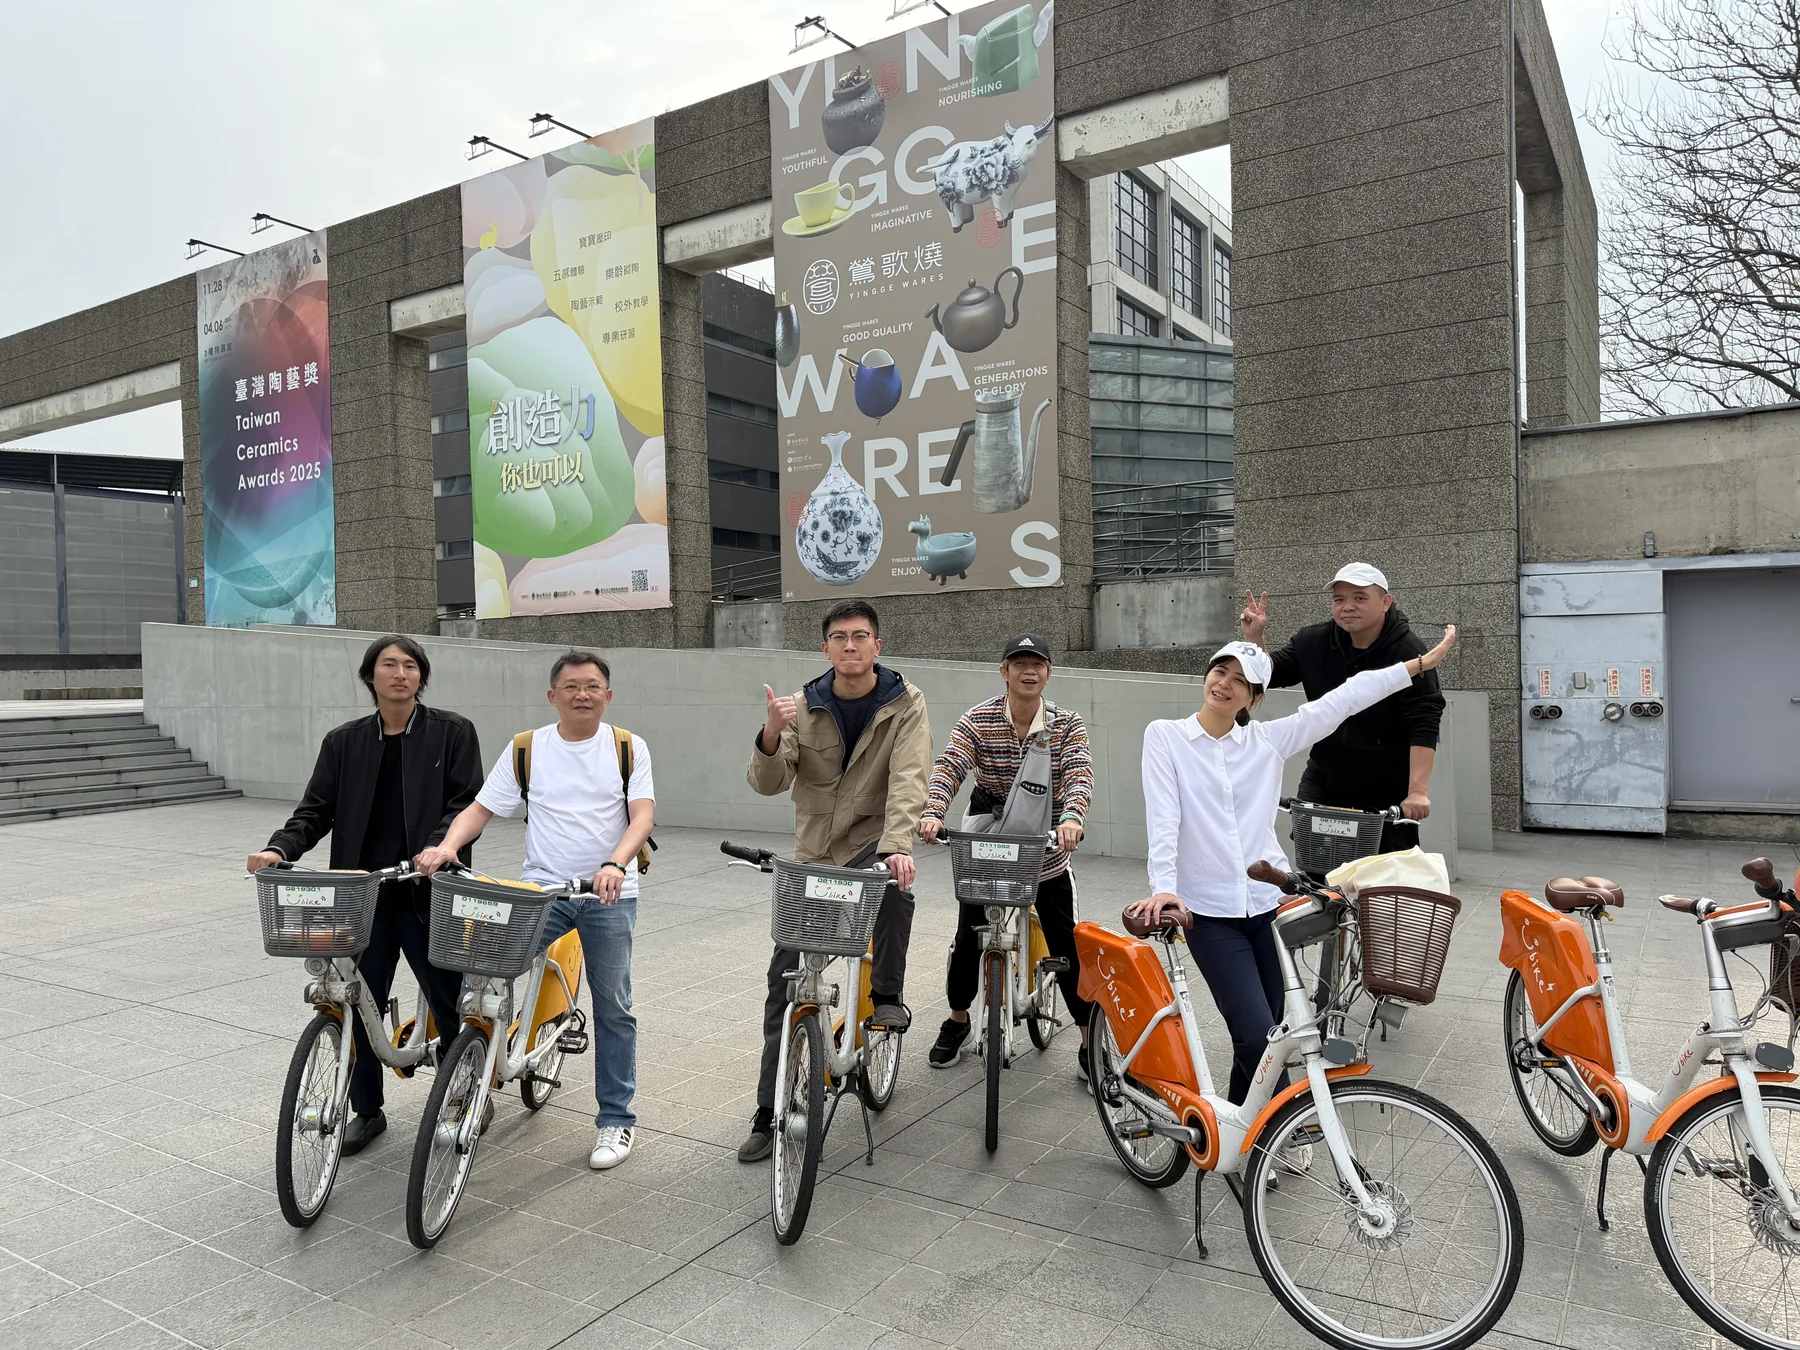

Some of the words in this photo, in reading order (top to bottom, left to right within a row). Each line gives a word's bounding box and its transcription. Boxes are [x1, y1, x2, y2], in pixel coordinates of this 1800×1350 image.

[938, 82, 959, 92] YINGGE
[960, 76, 979, 86] WARES
[938, 80, 1003, 107] NOURISHING
[782, 152, 800, 162] YINGGE
[800, 148, 817, 158] WARES
[781, 155, 829, 175] YOUTHFUL
[870, 208, 890, 219] YINGGE
[890, 204, 909, 214] WARES
[870, 209, 933, 233] IMAGINATIVE
[553, 264, 586, 282] 五感體驗
[848, 241, 943, 287] 鶯歌燒
[203, 279, 223, 296] 11.28
[849, 283, 894, 300] YINGGE
[902, 273, 944, 288] WARES
[570, 294, 604, 313] 陶藝示範
[614, 295, 649, 314] 校外教學
[203, 319, 224, 336] 04.06
[842, 321, 861, 330] YINGGE
[861, 317, 879, 327] WARES
[842, 330, 870, 343] GOOD
[872, 321, 914, 338] QUALITY
[602, 327, 636, 345] 專業研習
[973, 363, 995, 372] YINGGE
[995, 359, 1016, 368] WARES
[234, 361, 319, 402] 臺灣陶藝獎
[974, 365, 1048, 386] GENERATIONS
[974, 387, 989, 399] OF
[991, 381, 1027, 396] GLORY
[235, 410, 281, 432] Taiwan
[486, 384, 596, 456] 創造力
[236, 436, 299, 461] Ceramics
[237, 467, 285, 491] Awards
[289, 461, 321, 483] 2025
[500, 451, 585, 494] 你也可以
[891, 566, 922, 577] ENJOY
